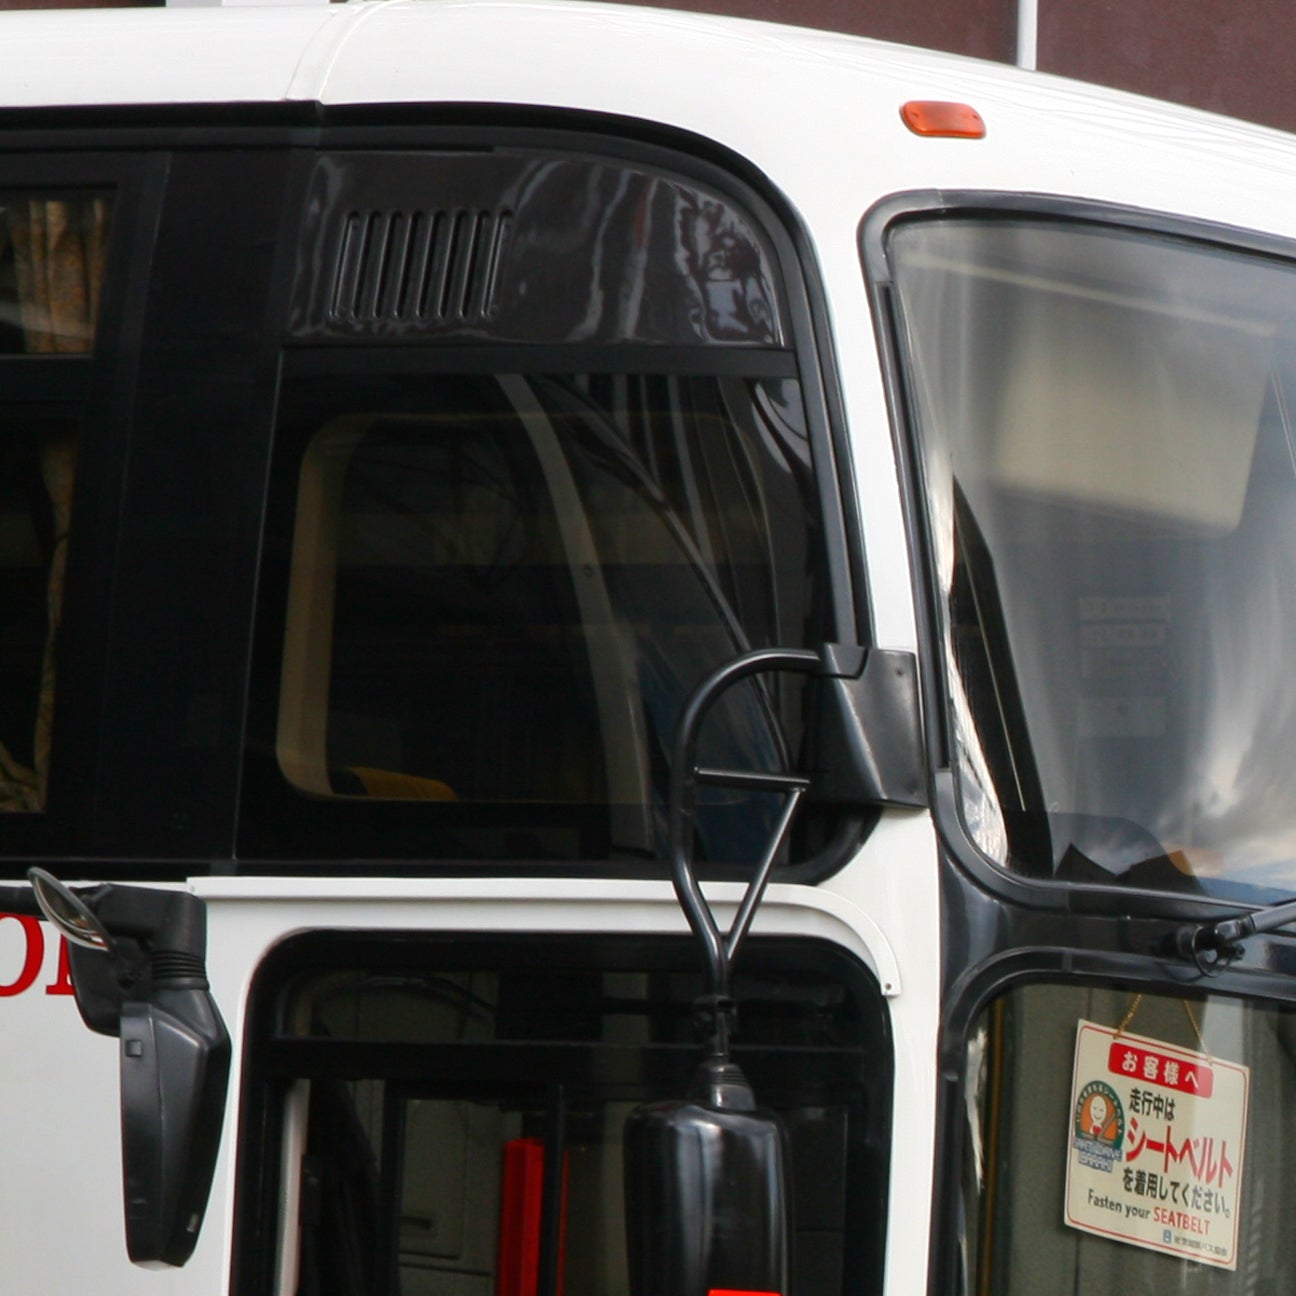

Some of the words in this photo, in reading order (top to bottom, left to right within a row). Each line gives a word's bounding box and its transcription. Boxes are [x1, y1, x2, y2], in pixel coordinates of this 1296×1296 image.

[1121, 1050, 1200, 1090] お客様へ
[1128, 1087, 1176, 1122] 走行中は
[1125, 1117, 1234, 1188] シートベルト
[1088, 1189, 1122, 1213] Fasten
[1125, 1201, 1151, 1220] your
[1152, 1206, 1211, 1236] SEATBELT
[1121, 1166, 1231, 1218] を着用してください。
